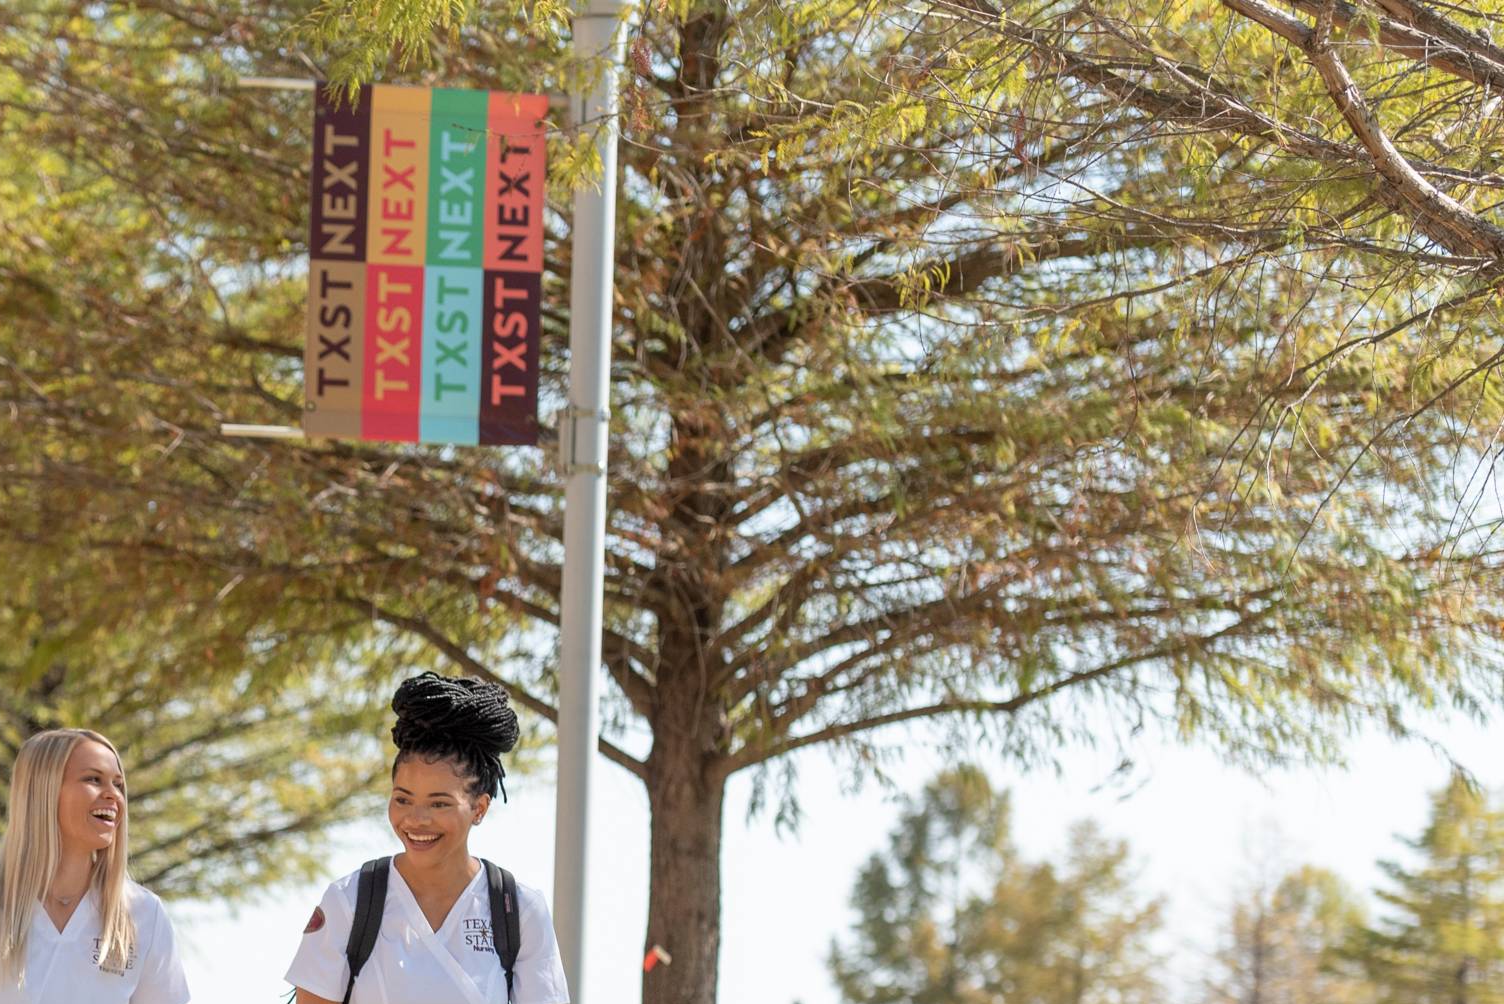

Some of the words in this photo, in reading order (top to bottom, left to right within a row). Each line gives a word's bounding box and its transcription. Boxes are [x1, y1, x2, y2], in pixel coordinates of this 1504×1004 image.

[321, 124, 359, 255] NEXT
[381, 128, 416, 257] NEXT
[438, 131, 475, 260] NEXT
[498, 134, 532, 263] NEXT
[317, 270, 353, 397] TXST
[375, 272, 412, 400] TXST
[434, 275, 470, 402] TXST
[491, 278, 529, 405] TXST
